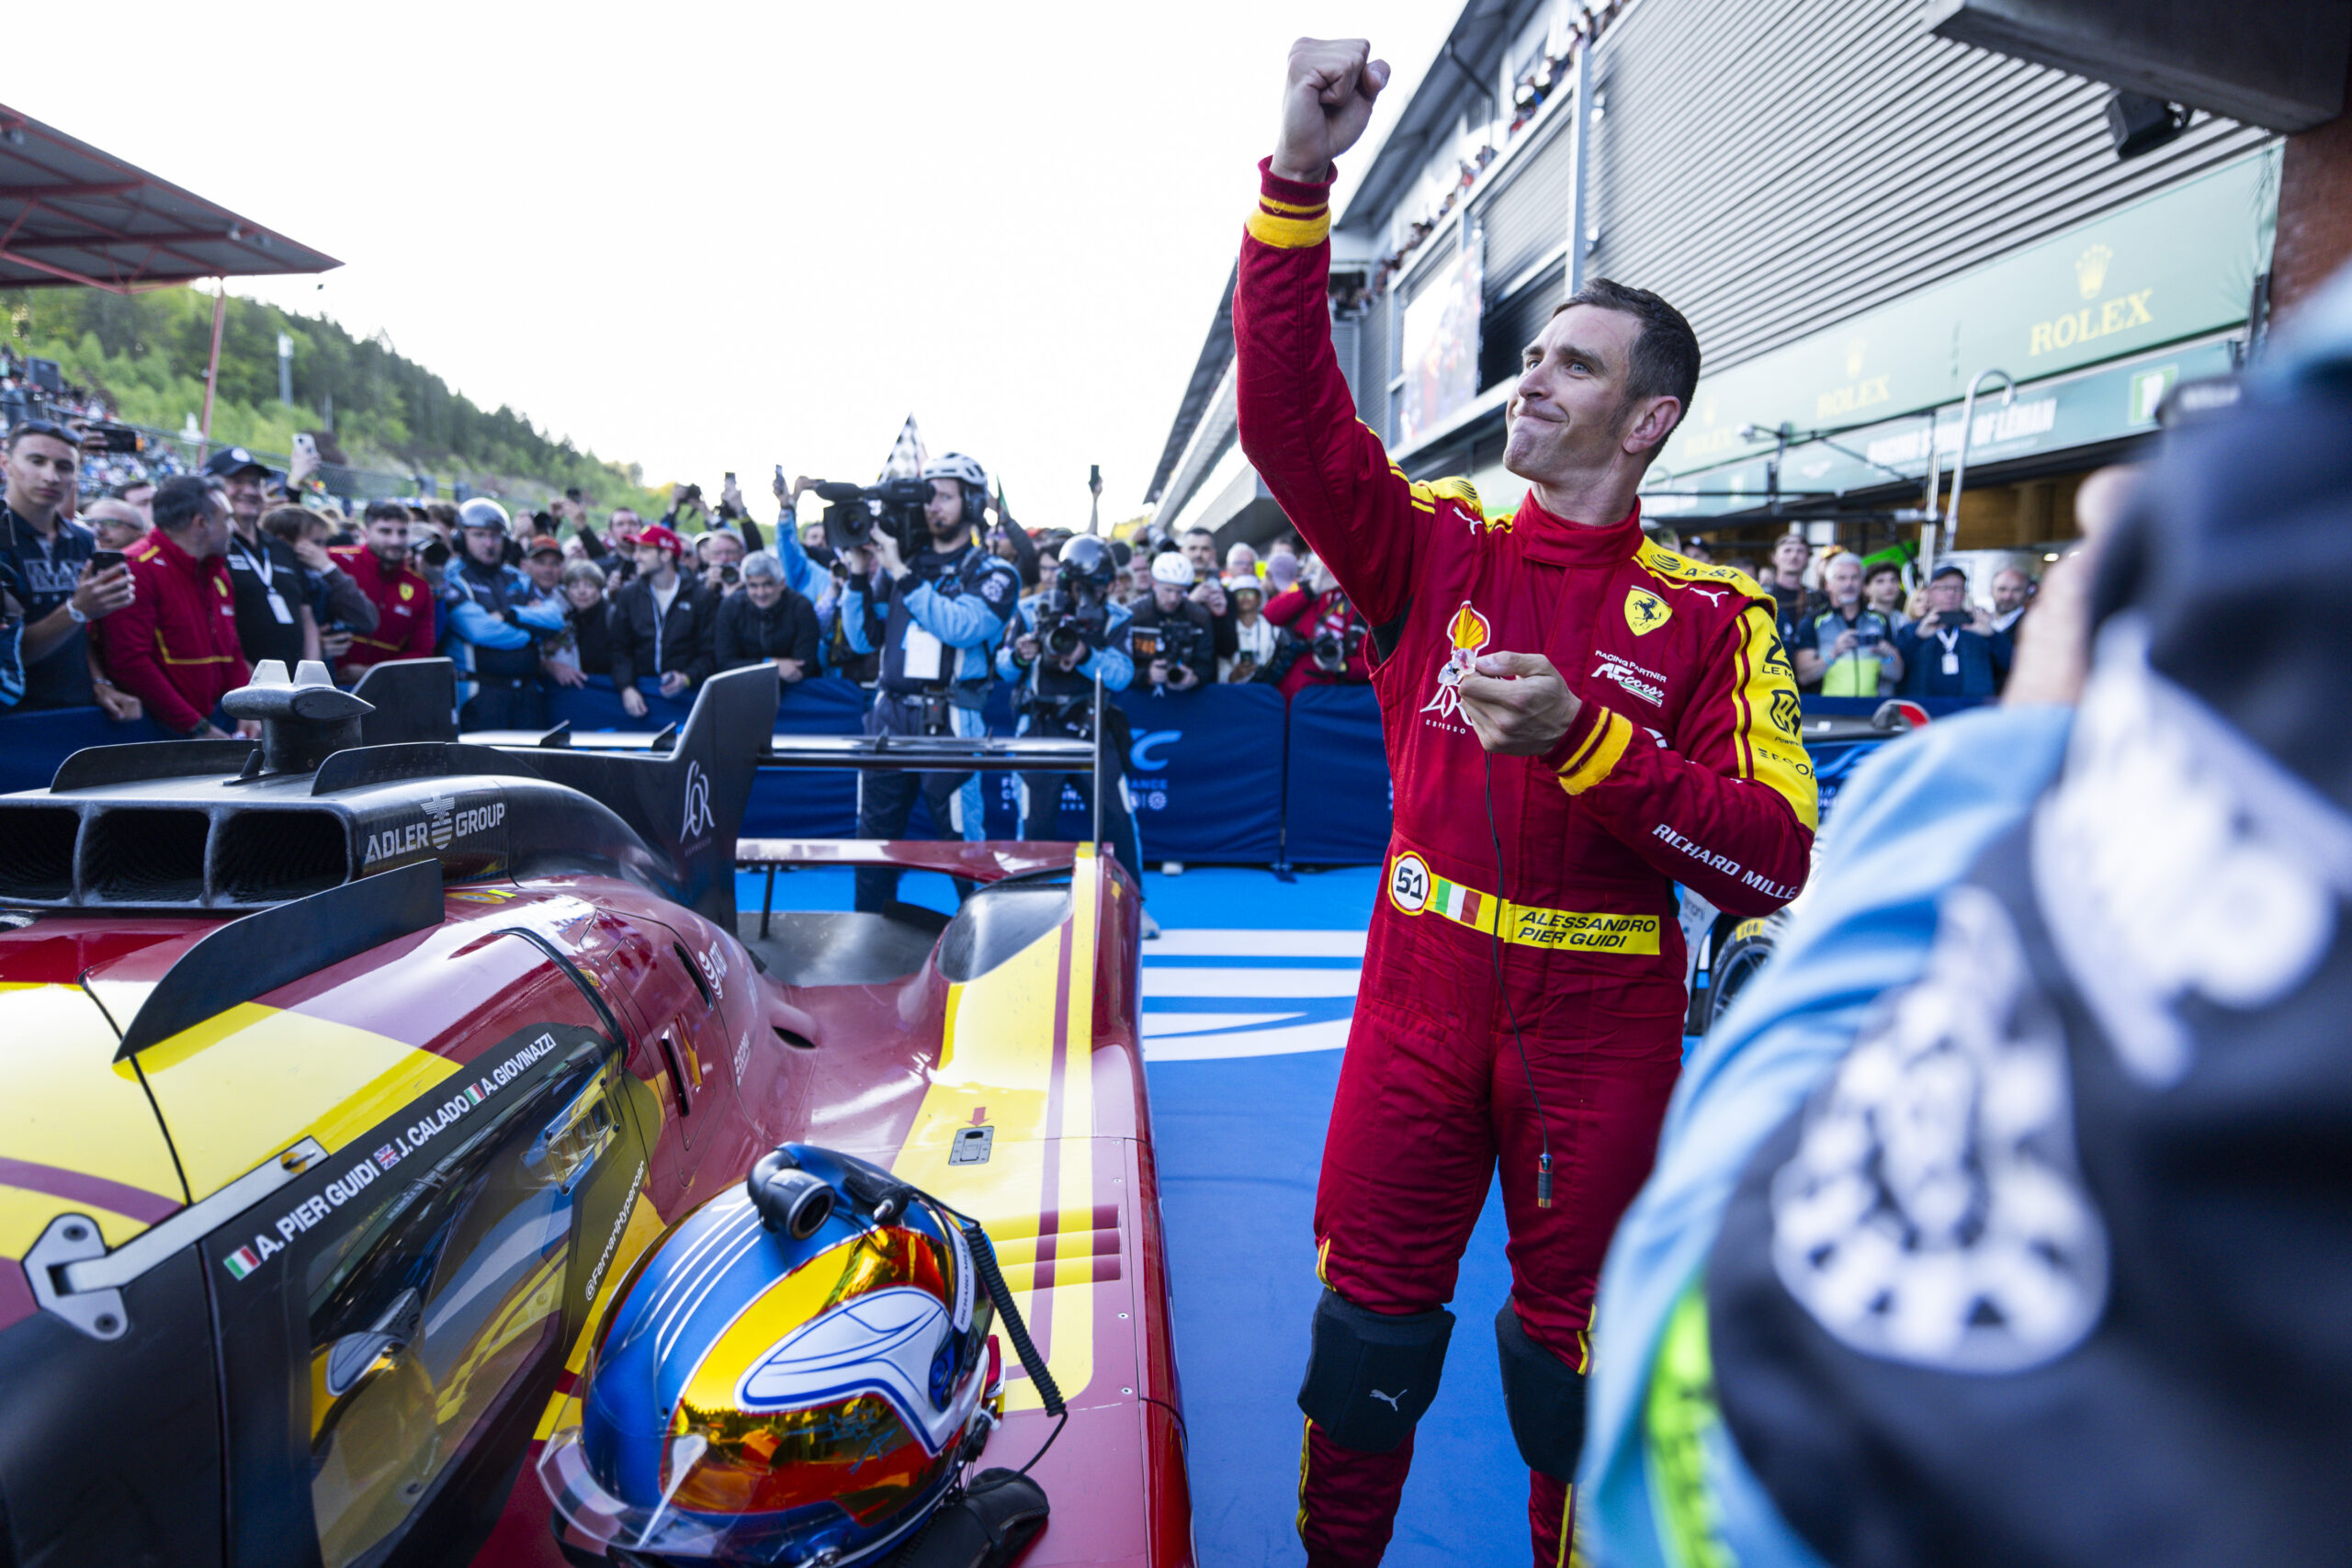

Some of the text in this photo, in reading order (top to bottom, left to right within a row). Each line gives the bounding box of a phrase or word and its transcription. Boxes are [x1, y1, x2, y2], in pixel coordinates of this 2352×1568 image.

[2029, 287, 2154, 357] ROLEX
[1816, 374, 1891, 420] ROLEX
[1595, 649, 1668, 683] RACING PARTNER
[1762, 664, 1781, 675] LE
[365, 802, 505, 863] ADLER GROUP
[1396, 866, 1423, 900] 51
[1652, 823, 1797, 899] RICHARD MILLE
[1518, 927, 1627, 948] PIER GUIDI
[1520, 911, 1656, 933] ALESSANDRO
[254, 1234, 285, 1262] A.
[276, 1194, 332, 1243] PIER
[324, 1158, 381, 1206] GUIDI
[395, 1137, 413, 1158] J.
[407, 1095, 470, 1146] CALADO
[481, 1077, 498, 1096] A.
[492, 1032, 557, 1086] GIOVINAZZI
[585, 1160, 644, 1301] @FerrariHypercar
